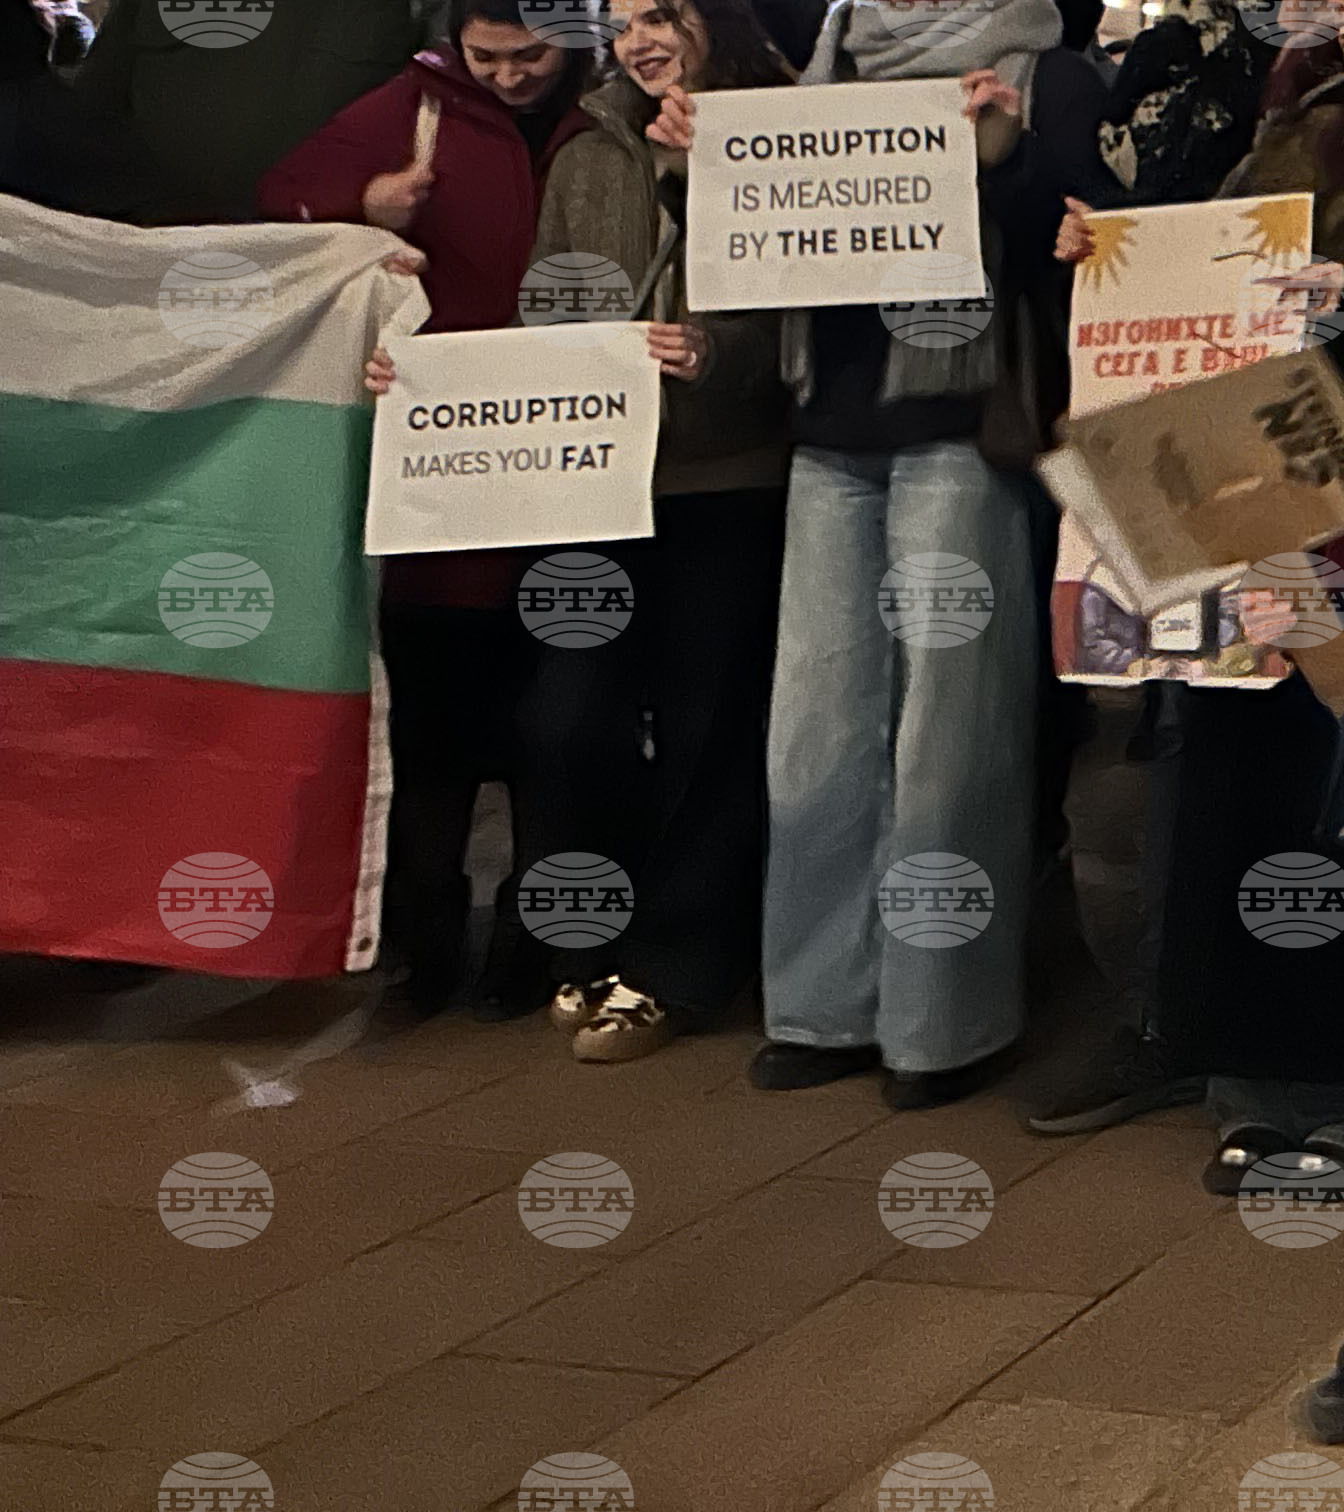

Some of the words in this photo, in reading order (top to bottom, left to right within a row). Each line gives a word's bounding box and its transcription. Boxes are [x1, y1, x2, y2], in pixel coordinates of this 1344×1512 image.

[724, 125, 948, 161] CORRUPTION
[733, 184, 760, 212] IS
[768, 175, 932, 210] MEASURED
[729, 231, 769, 260] BY
[777, 228, 838, 256] THE
[850, 223, 946, 253] BELLY
[1092, 350, 1160, 378] СЕГА
[1172, 347, 1189, 373] Е
[408, 392, 627, 431] CORRUPTION
[401, 451, 491, 479] MAKES
[497, 447, 552, 473] YOU
[560, 443, 615, 472] FAT
